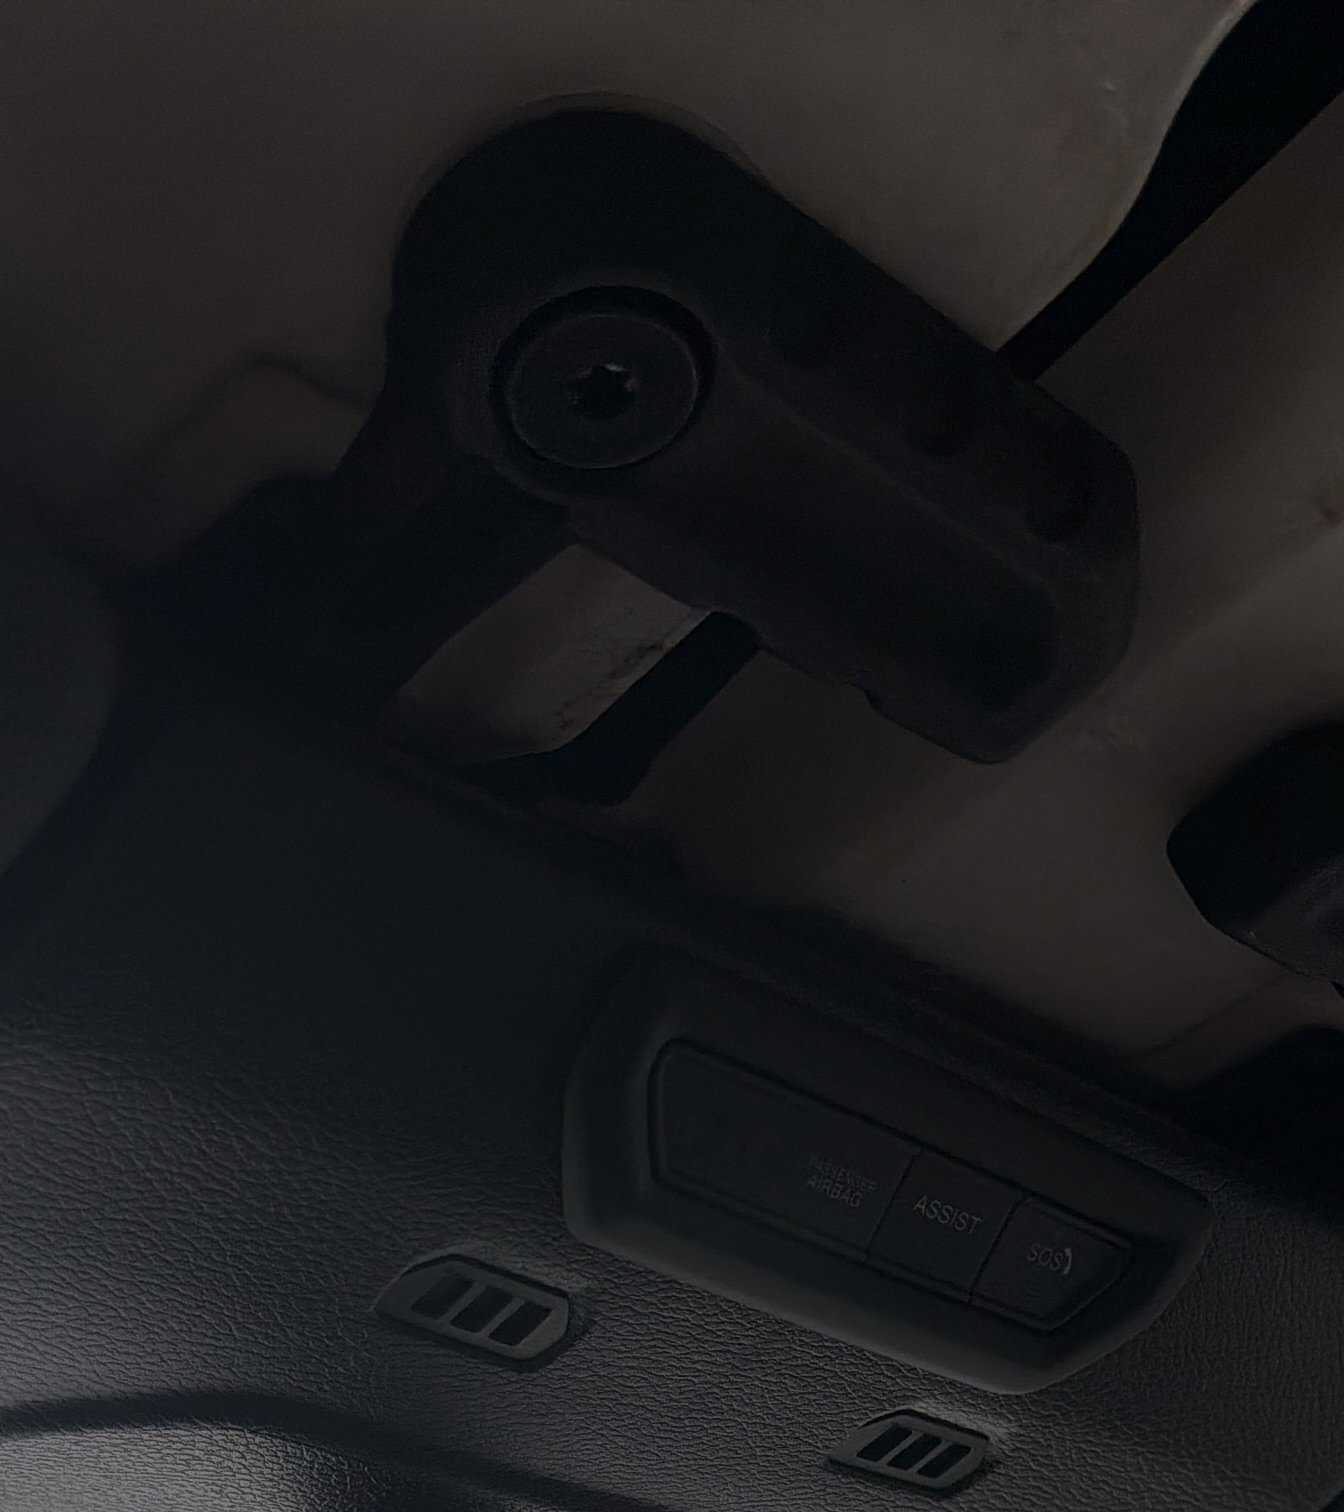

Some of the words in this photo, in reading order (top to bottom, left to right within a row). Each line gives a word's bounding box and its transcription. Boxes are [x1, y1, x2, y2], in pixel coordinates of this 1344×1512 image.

[806, 1173, 863, 1207] AIRBAG
[912, 1195, 983, 1235] ASSIST
[1027, 1244, 1064, 1271] SOS
